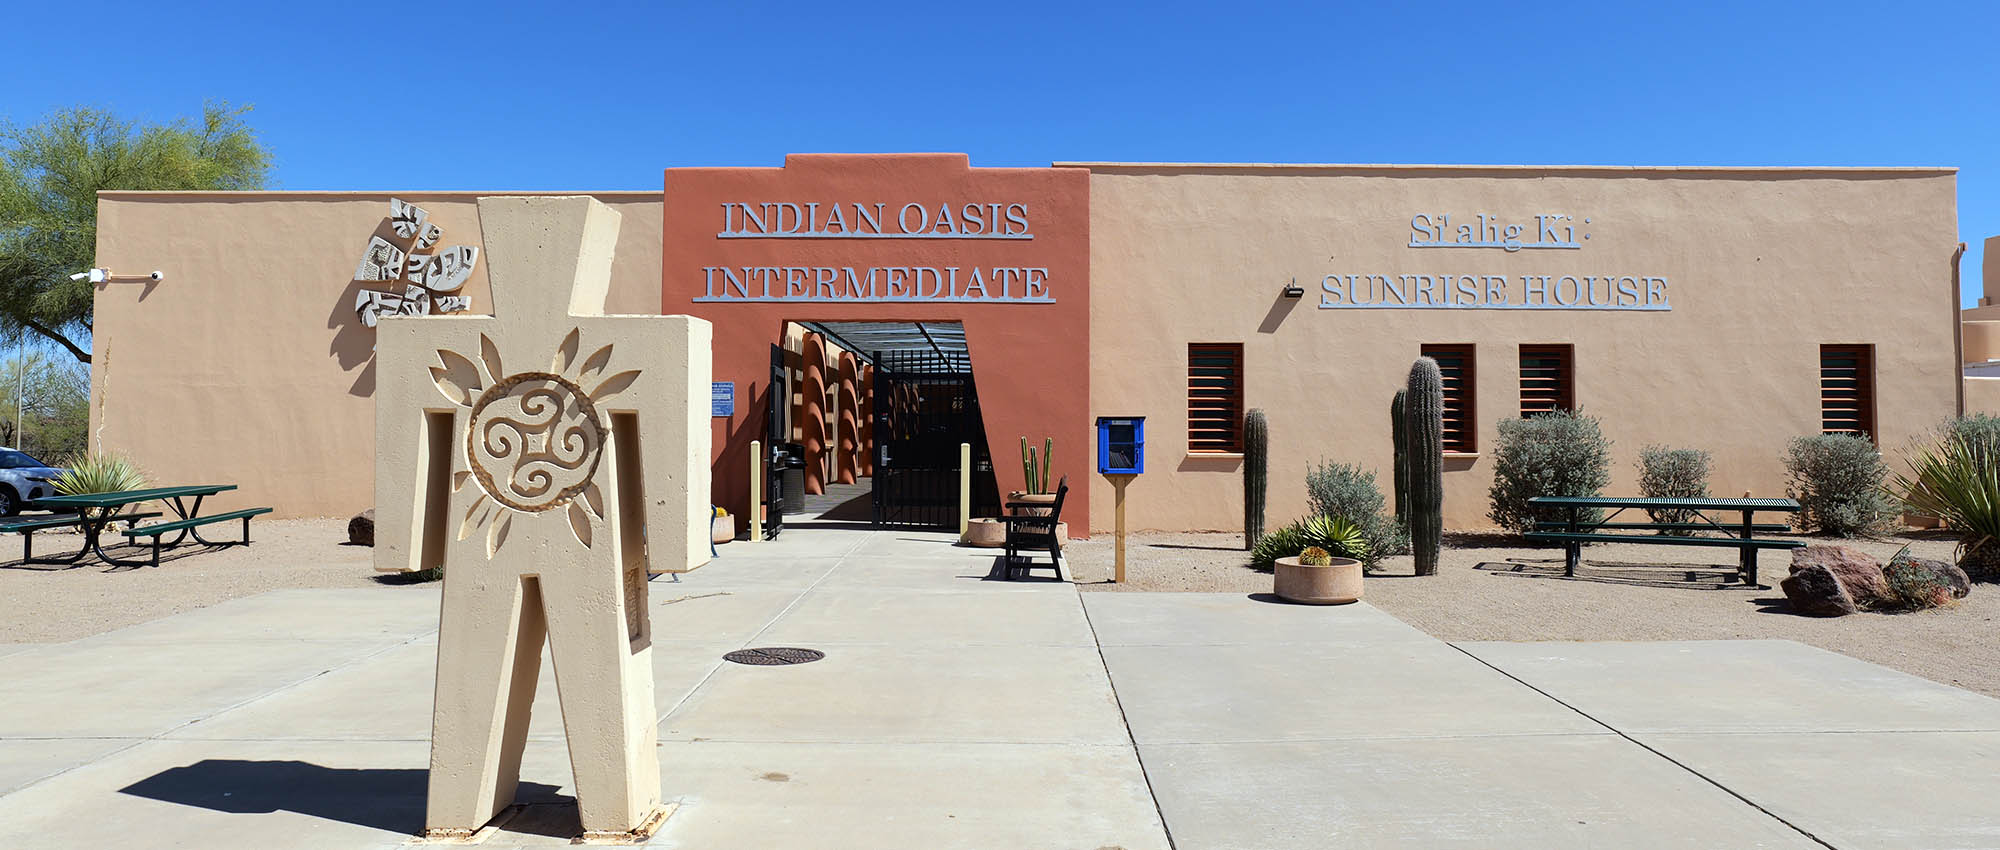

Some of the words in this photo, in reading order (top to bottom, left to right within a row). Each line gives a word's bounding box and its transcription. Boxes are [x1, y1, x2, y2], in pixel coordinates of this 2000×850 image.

[721, 202, 885, 234] INDIAN
[899, 202, 1029, 234] OASIS
[702, 266, 1049, 298] INTERMEDIATE
[1320, 274, 1507, 306] SUNRISE
[1520, 276, 1669, 306] HOUSE
